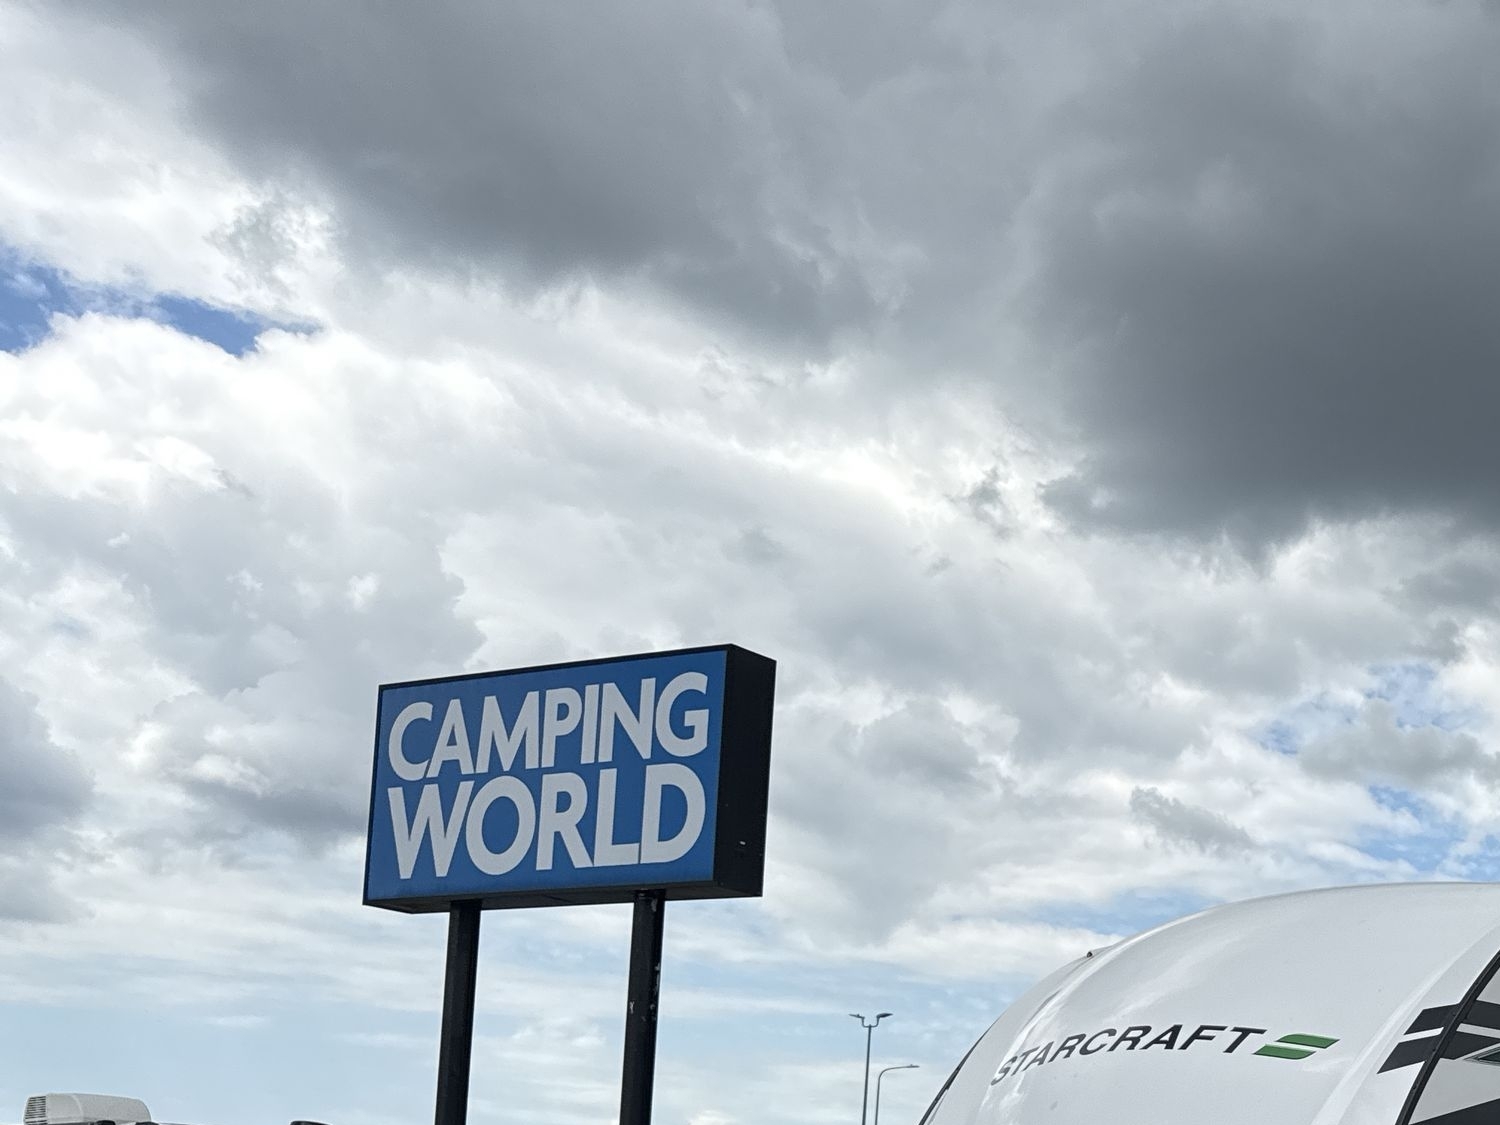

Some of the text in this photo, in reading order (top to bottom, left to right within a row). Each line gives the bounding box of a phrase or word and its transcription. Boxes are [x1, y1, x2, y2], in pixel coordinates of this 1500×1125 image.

[388, 671, 710, 781] CAMPING
[387, 763, 706, 880] WORLD
[991, 1024, 1268, 1086] STARCRAFT
